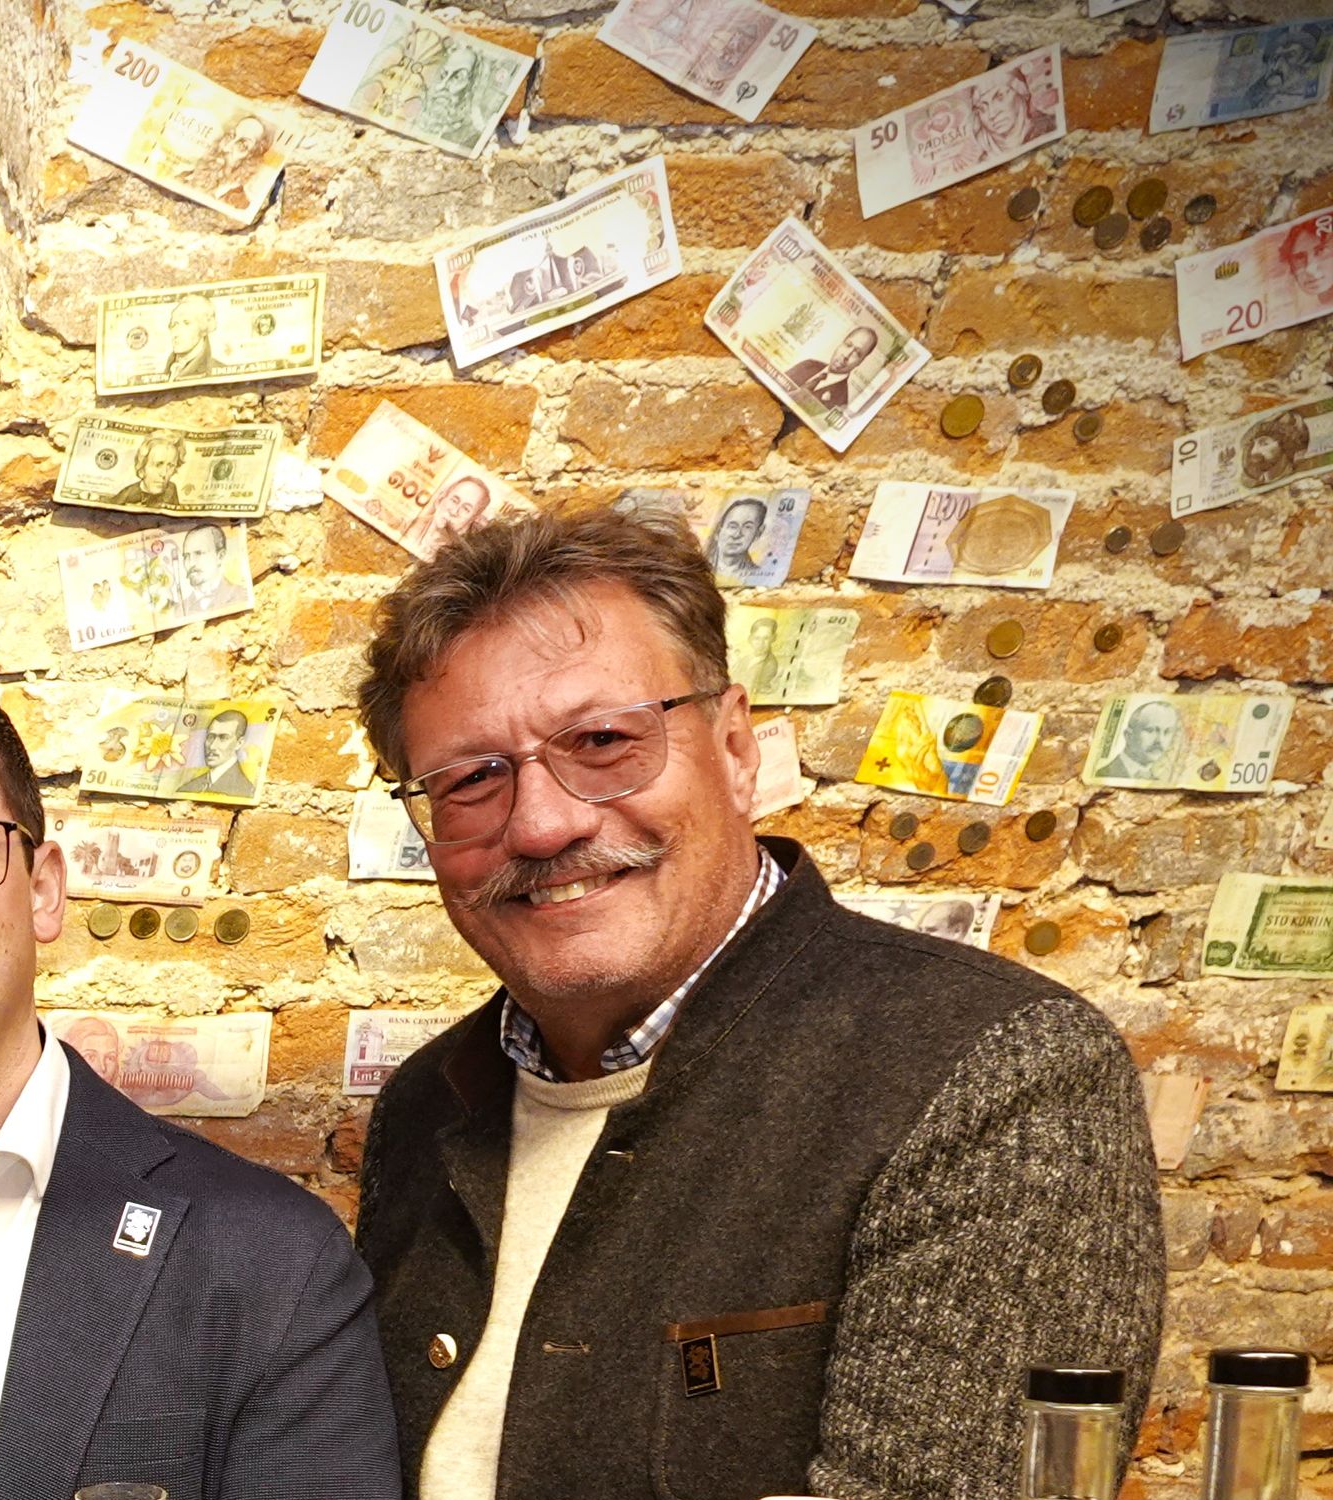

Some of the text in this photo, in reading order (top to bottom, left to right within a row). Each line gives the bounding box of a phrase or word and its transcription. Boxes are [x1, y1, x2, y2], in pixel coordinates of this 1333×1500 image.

[770, 24, 799, 52] 50
[114, 50, 161, 89] 200
[870, 120, 898, 150] 50
[1225, 300, 1264, 336] 20
[1178, 439, 1198, 466] 10
[777, 496, 796, 513] 50
[76, 624, 97, 644] 10
[757, 725, 780, 741] 00
[85, 769, 108, 786] 50
[974, 771, 1000, 796] 10
[1229, 762, 1269, 785] 500
